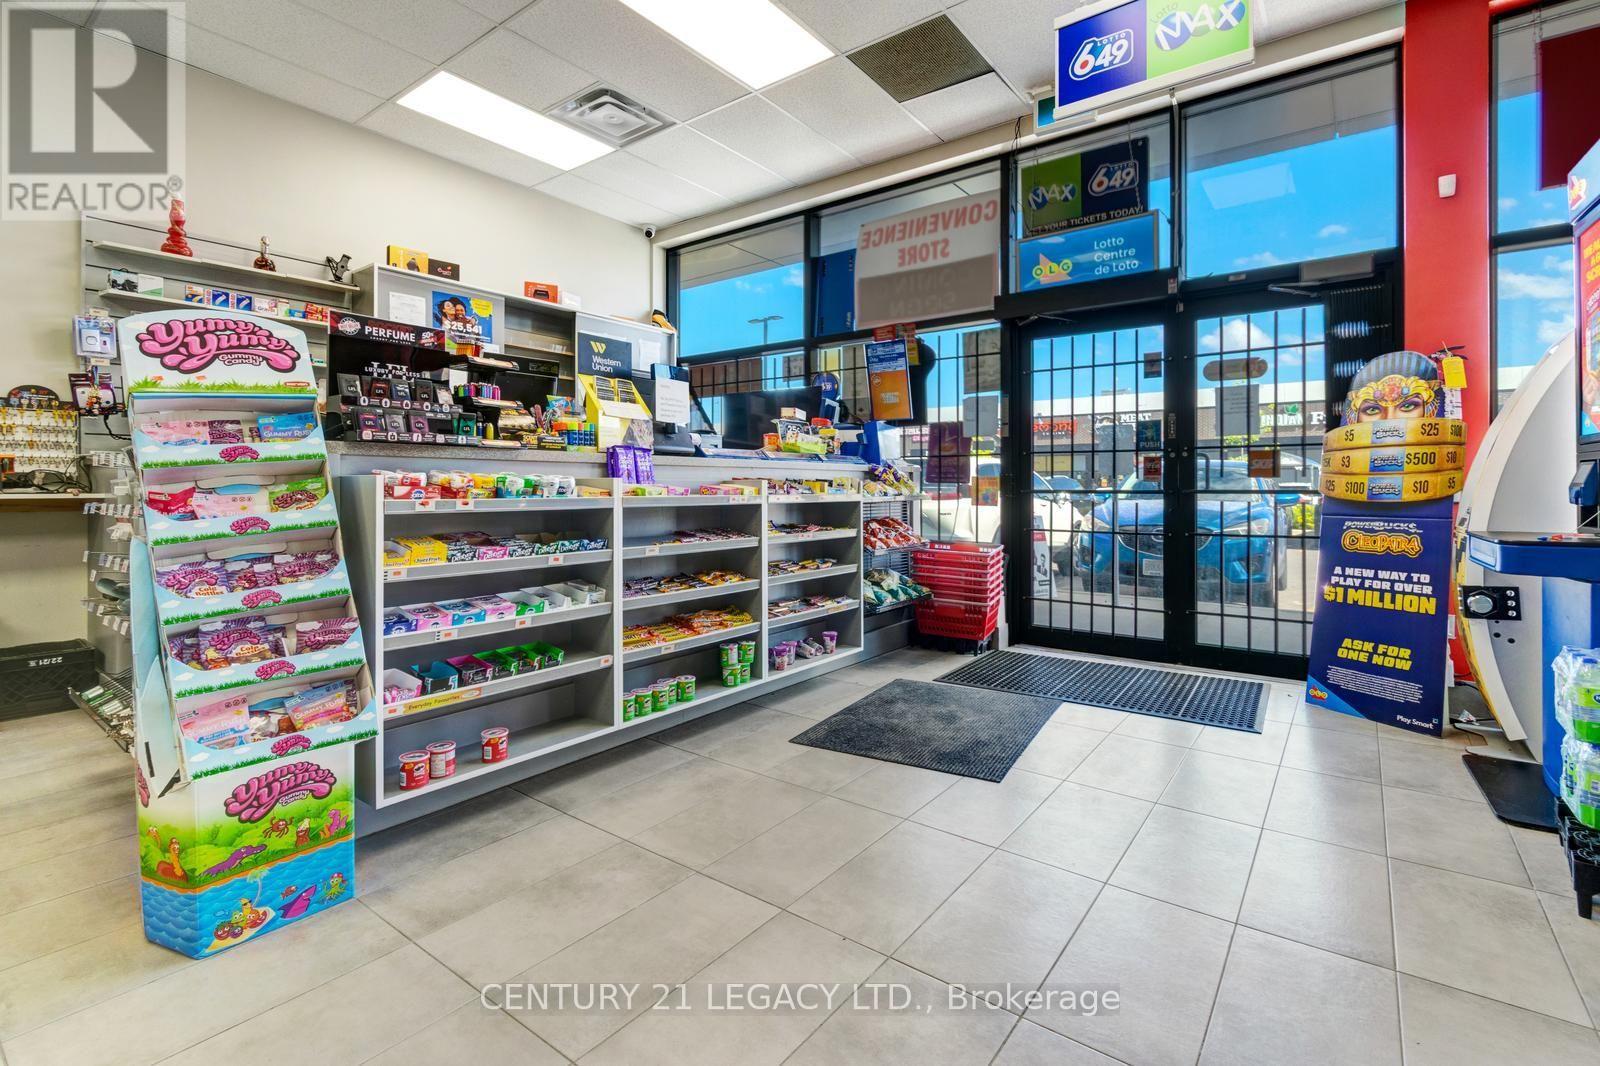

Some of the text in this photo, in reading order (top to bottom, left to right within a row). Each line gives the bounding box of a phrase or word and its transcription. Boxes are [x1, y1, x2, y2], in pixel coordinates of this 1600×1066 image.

[1156, 0, 1240, 51] MAX
[1097, 31, 1127, 46] LOTTO
[1073, 38, 1130, 77] 649
[1092, 166, 1135, 193] 649
[1028, 183, 1074, 210] MAX
[1044, 221, 1068, 232] YOUR
[1070, 212, 1108, 226] TICKETS
[1109, 205, 1144, 219] TODAY!
[1094, 236, 1124, 250] Lotto
[1094, 247, 1136, 262] Centre
[1033, 259, 1073, 279] OLG
[1094, 259, 1139, 275] de Loto
[365, 325, 416, 342] PERFUME
[218, 353, 263, 362] Gummy
[592, 354, 621, 366] Western
[592, 364, 613, 374] Union
[1120, 413, 1152, 422] MEAT
[1344, 429, 1354, 442] $5
[1421, 423, 1439, 436] $25
[1341, 455, 1350, 468] $3
[1405, 452, 1437, 465] $500
[1345, 481, 1365, 495] $100
[1412, 480, 1429, 493] $10
[1447, 477, 1456, 489] $5
[1342, 530, 1422, 557] CLEOPATRA
[1333, 566, 1431, 583] A NEW WAY TO
[1330, 576, 1433, 595] PLAY FOR OVER
[1323, 585, 1436, 615] $1 MILLION
[1341, 638, 1411, 658] ASK FOR
[1336, 648, 1412, 671] ONE NOW
[408, 701, 432, 710] Everyday
[1396, 714, 1434, 730] Play Smart
